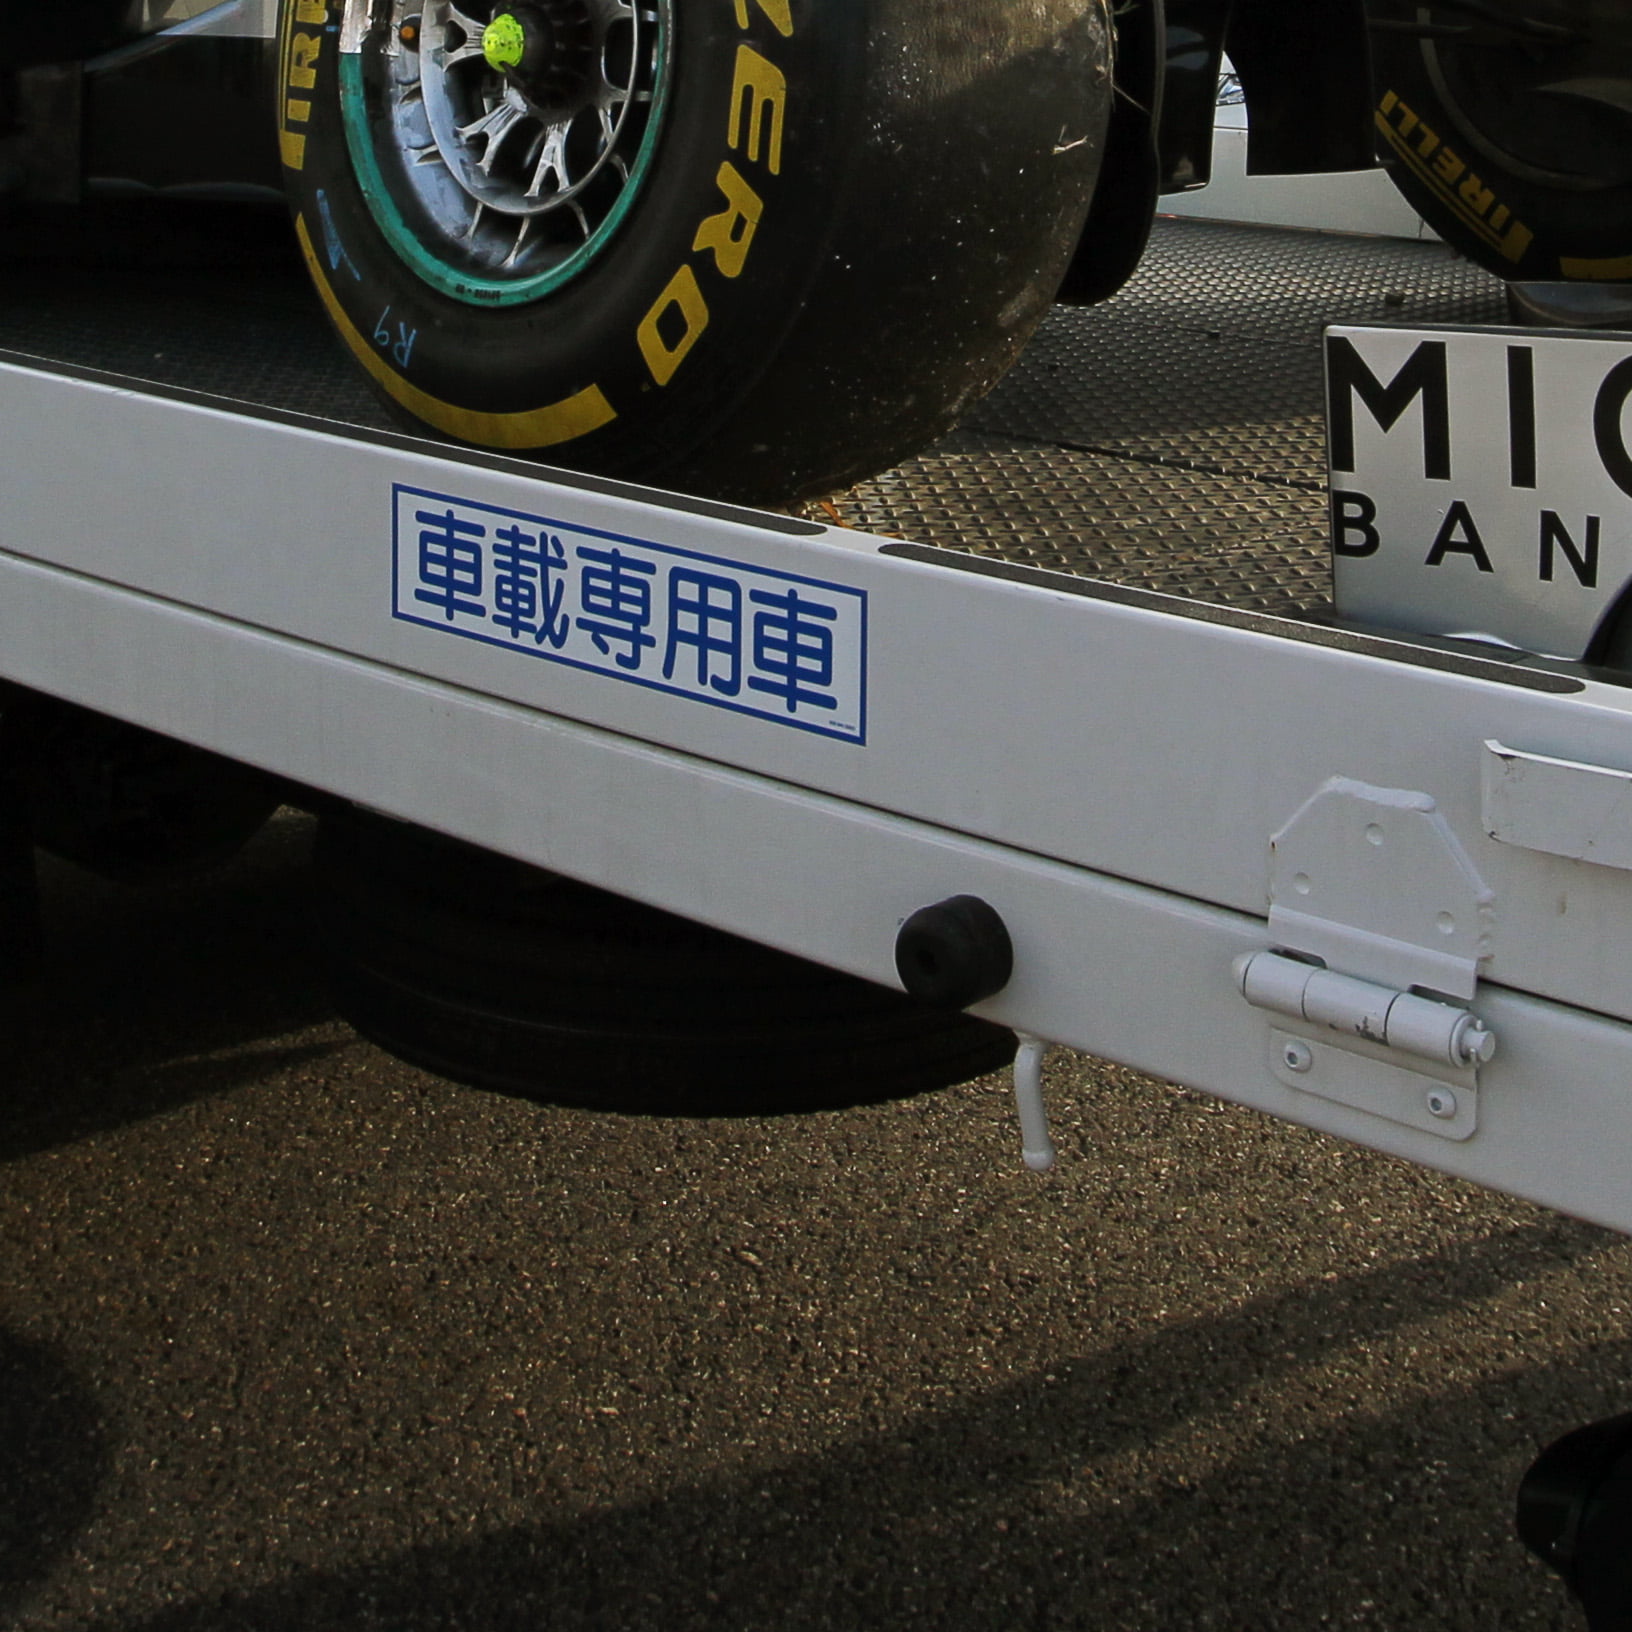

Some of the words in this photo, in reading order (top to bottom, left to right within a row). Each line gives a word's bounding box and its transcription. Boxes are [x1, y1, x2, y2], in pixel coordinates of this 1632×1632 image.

[1374, 89, 1534, 263] PIRELLI
[414, 509, 838, 714] 車載専用車
